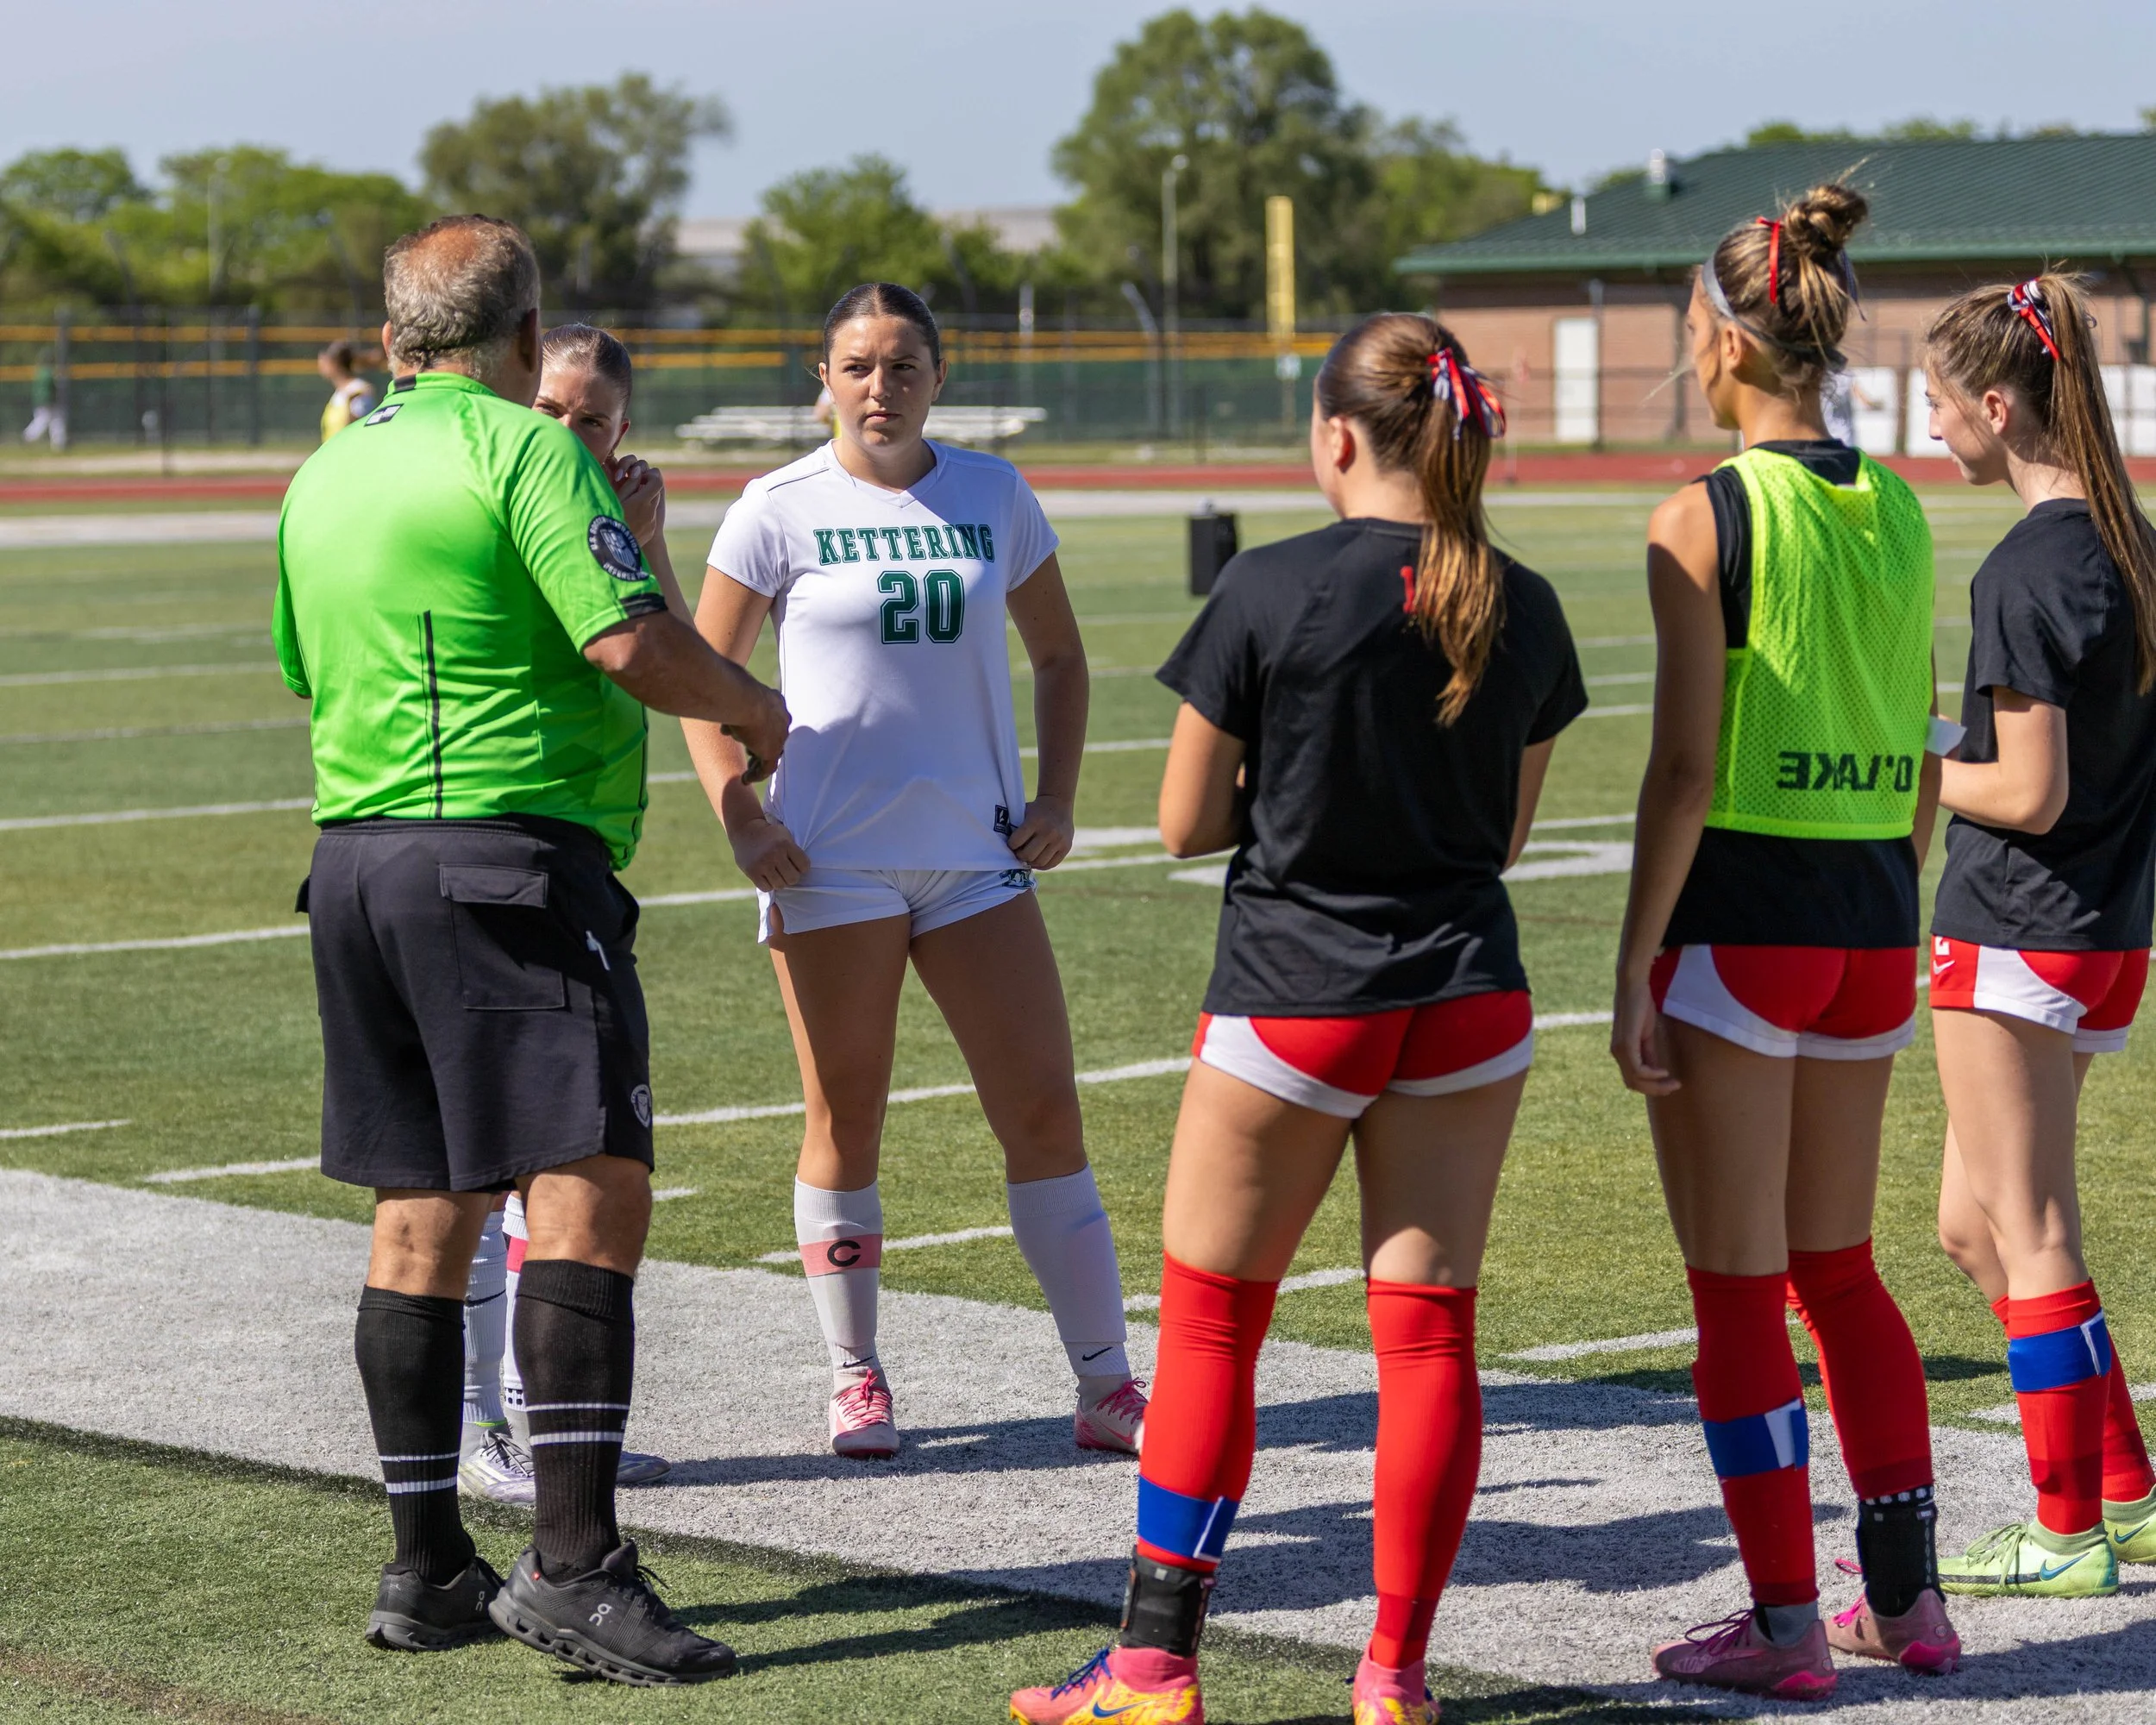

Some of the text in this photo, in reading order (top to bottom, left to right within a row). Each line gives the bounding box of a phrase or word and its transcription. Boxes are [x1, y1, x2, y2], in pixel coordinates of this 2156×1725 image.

[813, 524, 994, 566] KETTERING
[877, 569, 965, 644] 20
[826, 1239, 862, 1267] C
